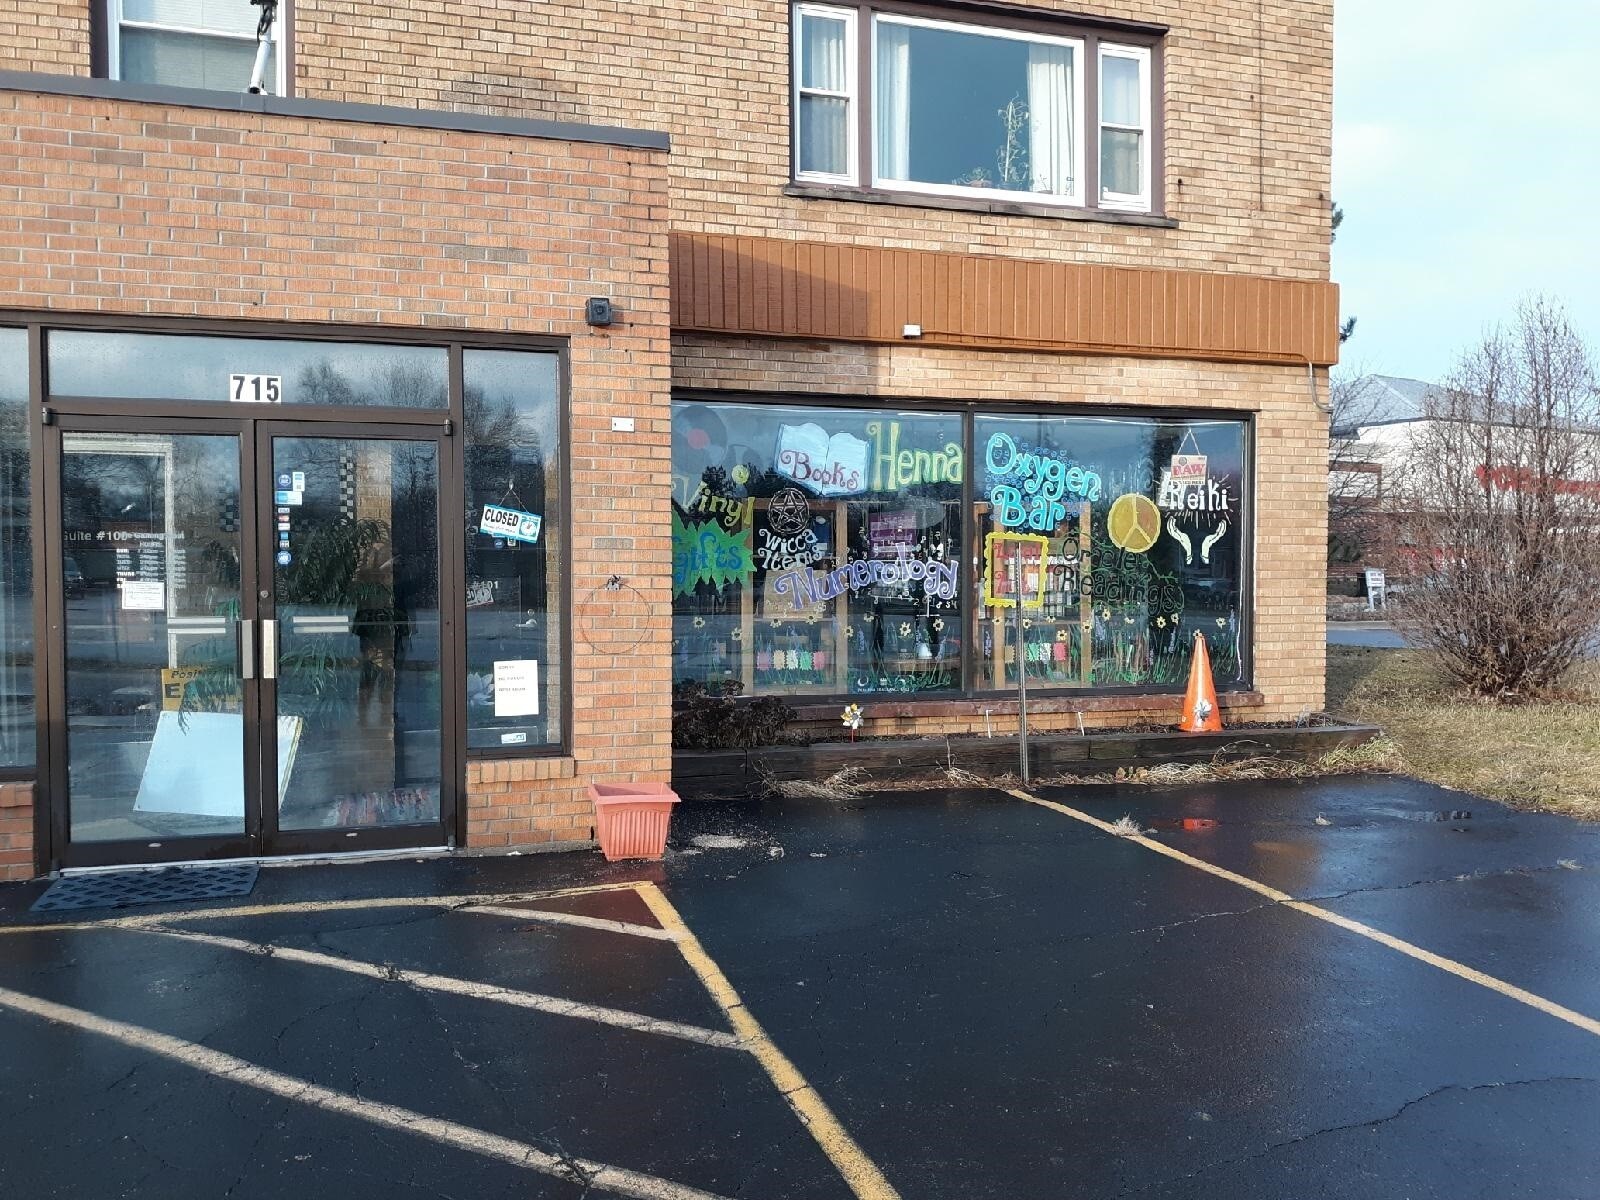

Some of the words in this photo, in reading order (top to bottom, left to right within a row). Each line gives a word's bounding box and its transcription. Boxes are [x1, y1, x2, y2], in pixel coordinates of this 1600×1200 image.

[232, 375, 280, 402] 715
[779, 449, 860, 491] Books
[867, 421, 964, 492] Henna
[985, 432, 1102, 502] Oxygen
[671, 474, 756, 527] Vinyl
[991, 484, 1066, 531] Bar
[1167, 478, 1229, 512] Reiki
[484, 508, 519, 527] CLOSED
[757, 544, 823, 571] Items
[758, 528, 818, 554] Wicca
[774, 542, 960, 611] Numerology
